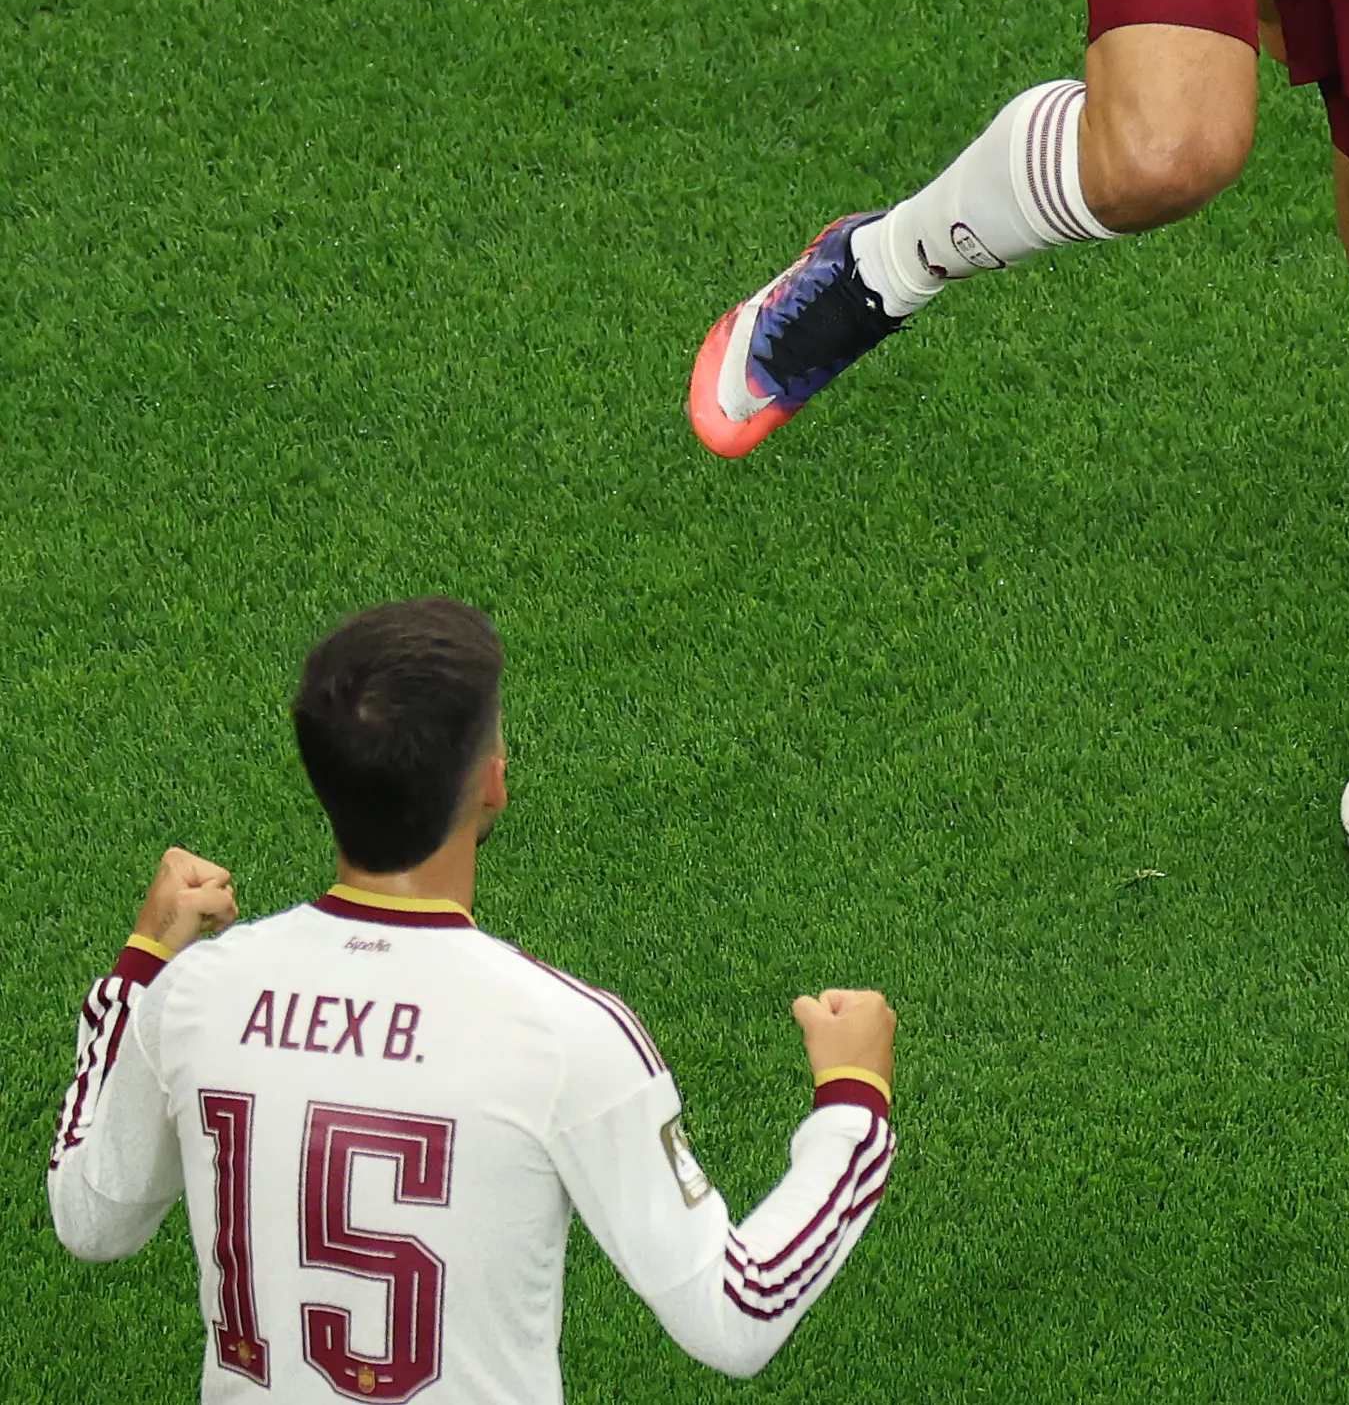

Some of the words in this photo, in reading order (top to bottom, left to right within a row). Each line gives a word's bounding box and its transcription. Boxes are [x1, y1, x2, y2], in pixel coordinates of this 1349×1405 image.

[240, 990, 376, 1057] ALEX
[383, 1002, 424, 1063] B.
[198, 1088, 457, 1405] 15
